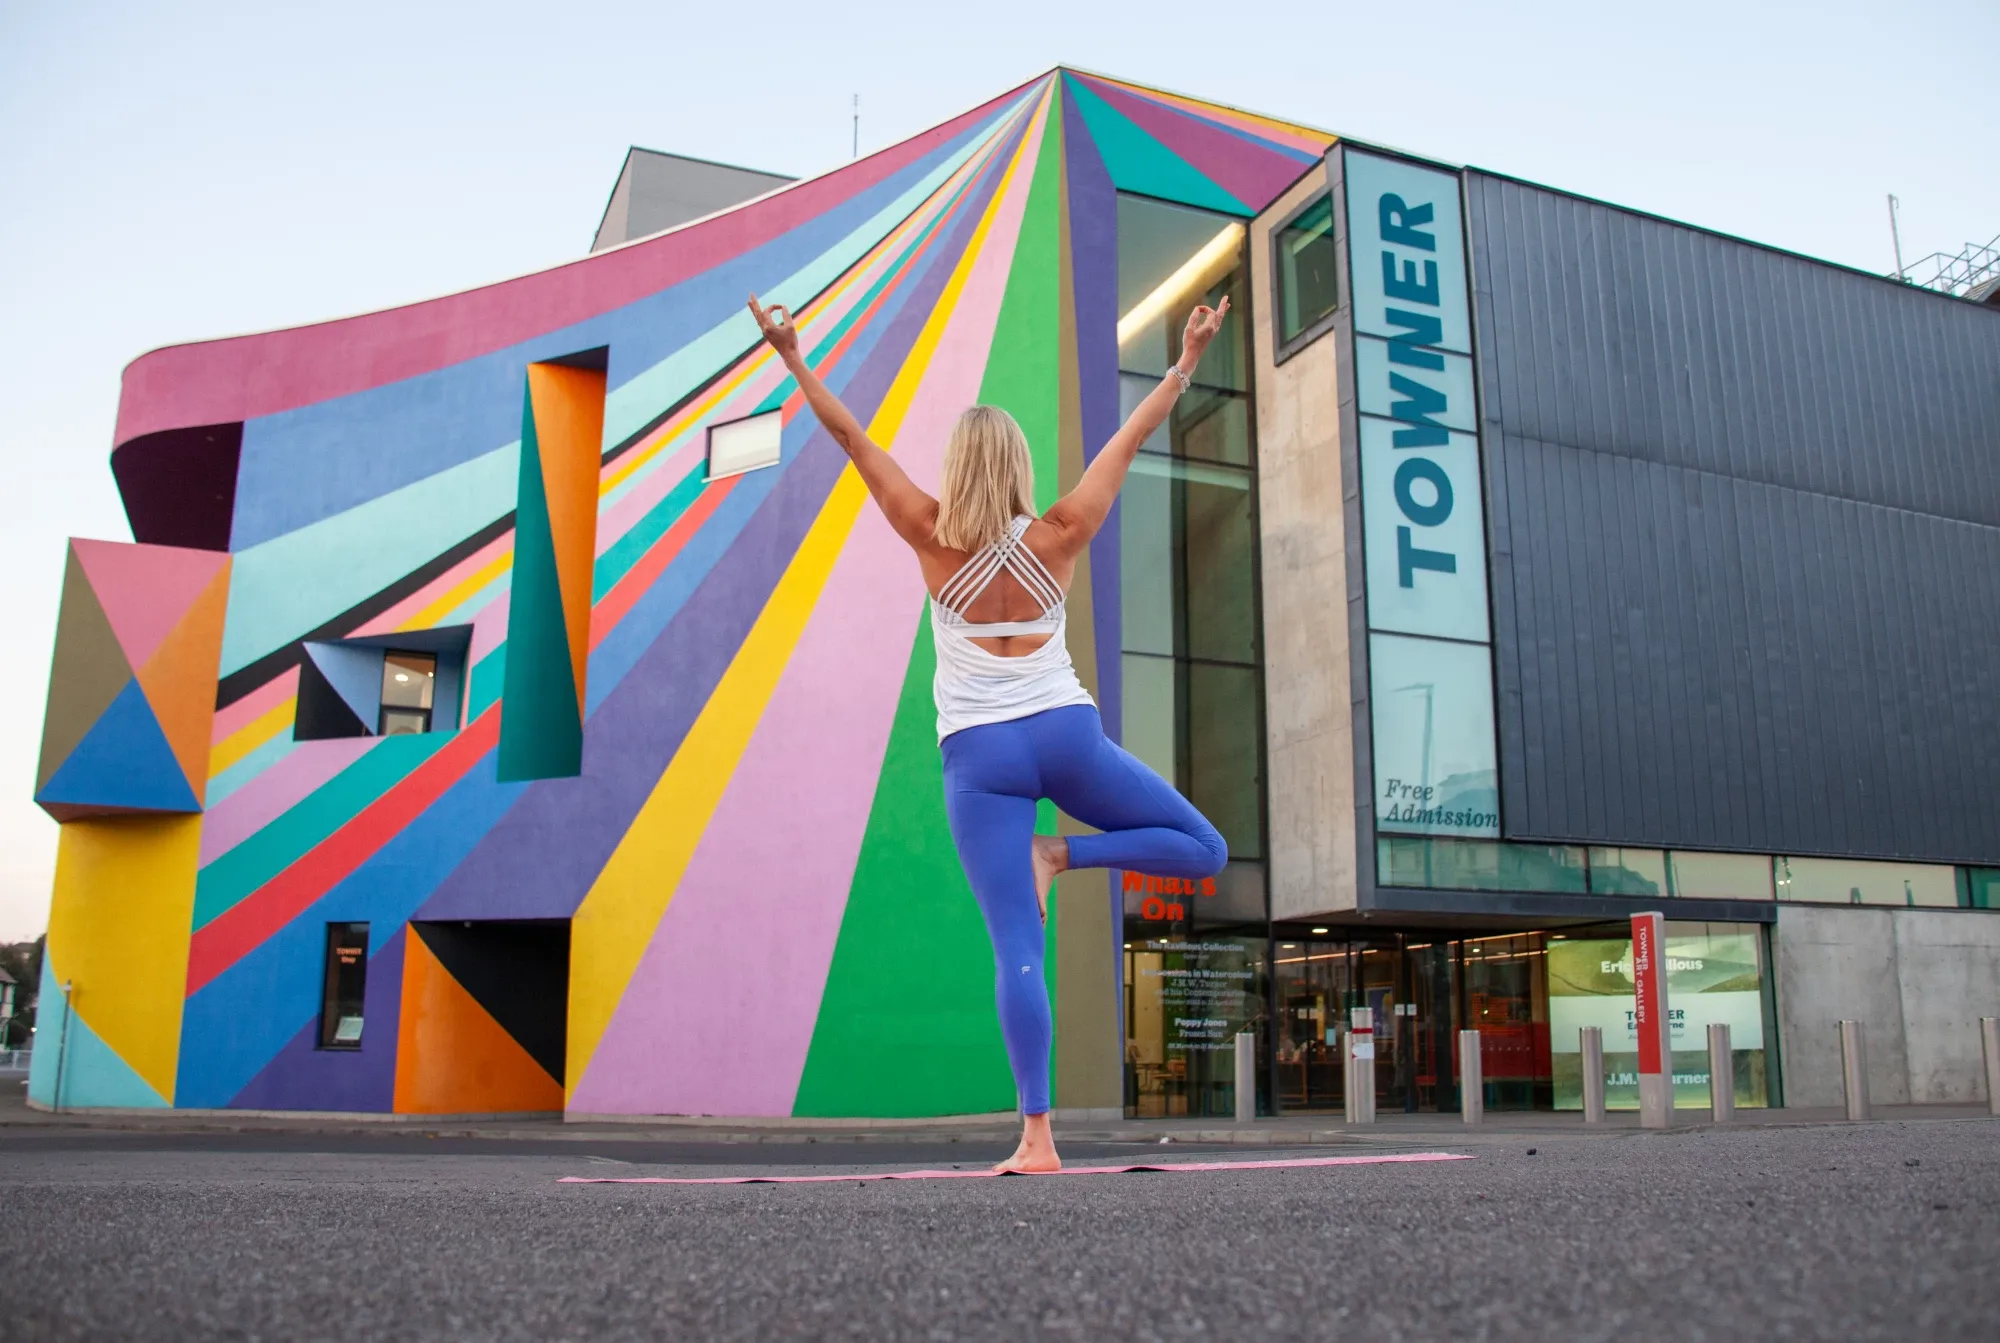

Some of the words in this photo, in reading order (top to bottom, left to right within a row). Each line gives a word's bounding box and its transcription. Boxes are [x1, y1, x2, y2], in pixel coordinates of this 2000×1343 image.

[1378, 192, 1457, 589] TOWNER
[1384, 779, 1434, 801] Free
[1384, 803, 1499, 829] Admission
[1141, 896, 1184, 921] On
[1639, 926, 1648, 970] TOWNER
[1601, 960, 1632, 973] Eric
[1635, 957, 1643, 977] ART
[1636, 980, 1645, 1023] GALLERY
[1624, 1009, 1685, 1021] TER
